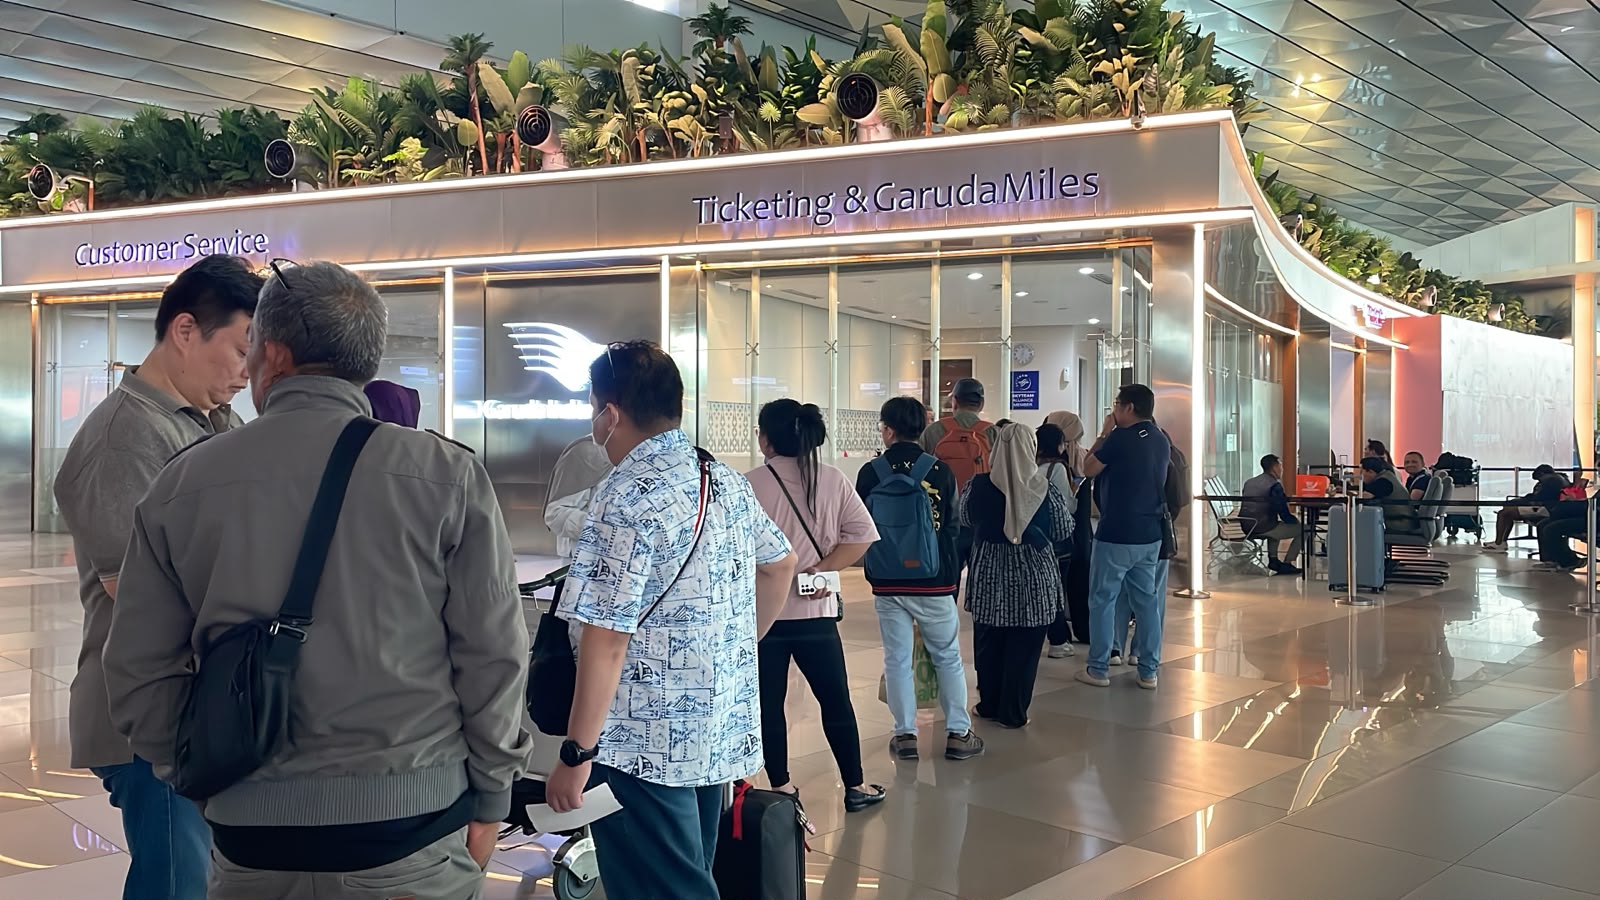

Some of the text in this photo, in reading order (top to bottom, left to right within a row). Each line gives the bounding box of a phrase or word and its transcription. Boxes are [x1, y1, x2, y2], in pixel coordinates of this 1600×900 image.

[692, 167, 1099, 228] Ticketing & GarudaMiles
[75, 229, 269, 267] Customer Service
